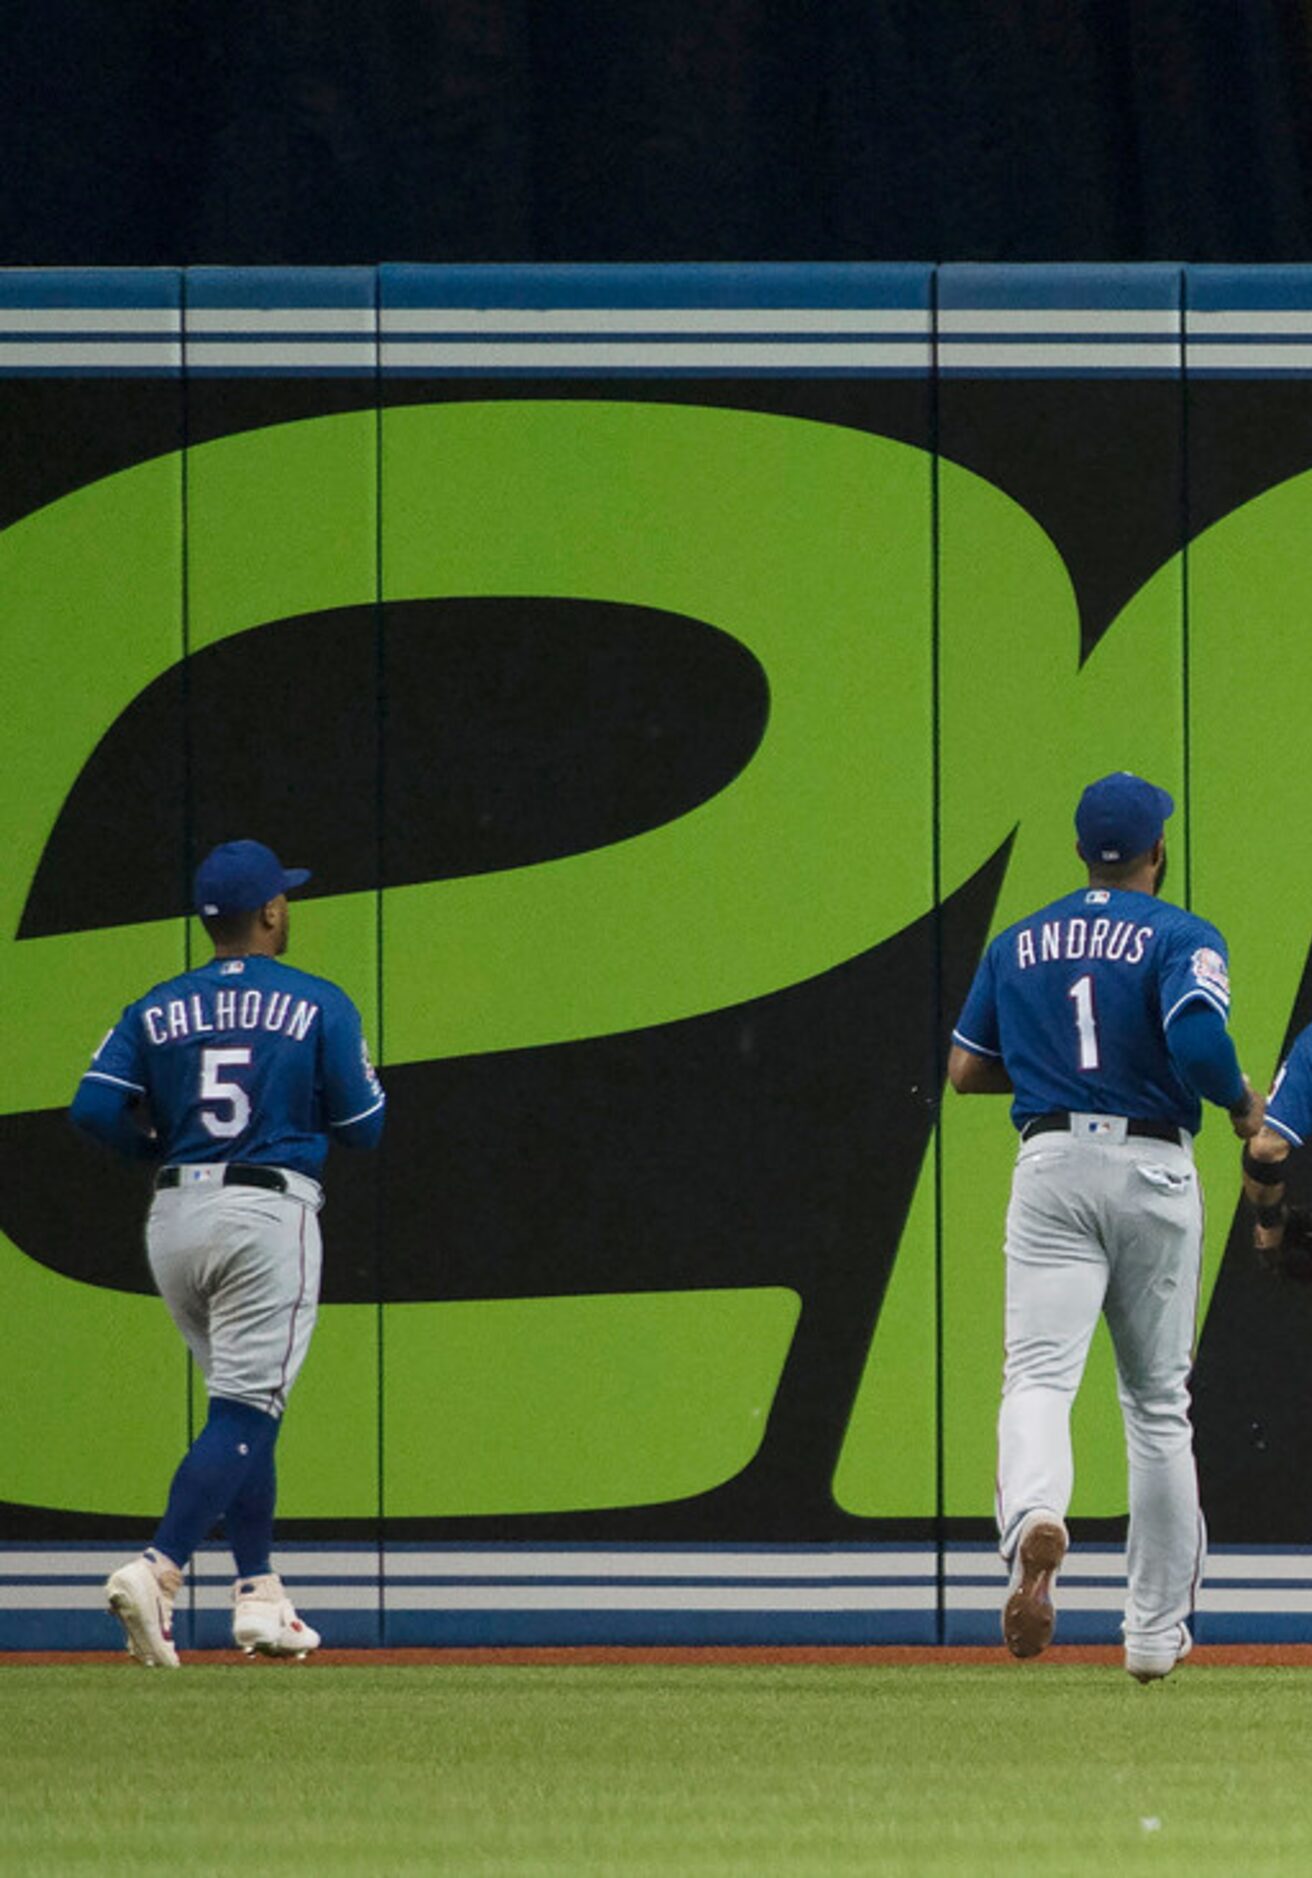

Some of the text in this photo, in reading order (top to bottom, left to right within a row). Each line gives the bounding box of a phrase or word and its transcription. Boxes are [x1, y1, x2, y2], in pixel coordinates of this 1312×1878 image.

[1016, 917, 1154, 969] ANDRUS
[142, 989, 320, 1046] CALHOUN
[1068, 973, 1100, 1071] 1
[199, 1046, 252, 1139] 5
